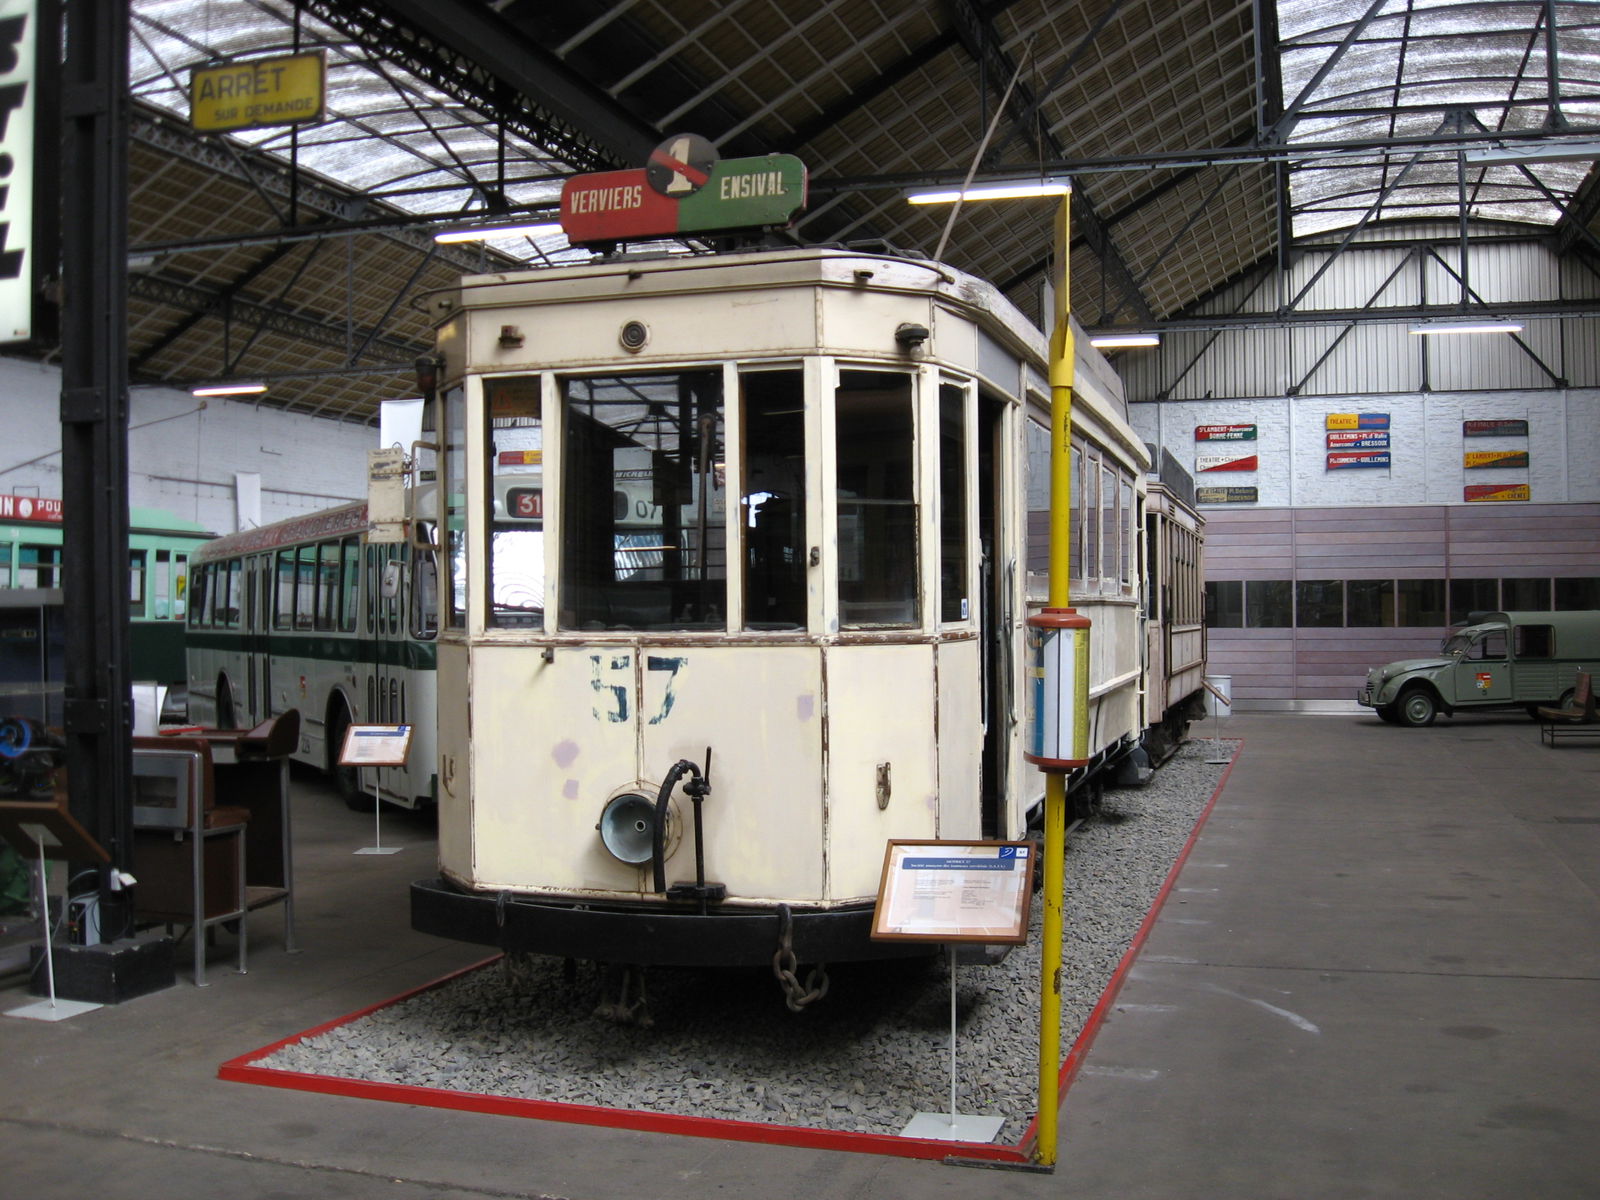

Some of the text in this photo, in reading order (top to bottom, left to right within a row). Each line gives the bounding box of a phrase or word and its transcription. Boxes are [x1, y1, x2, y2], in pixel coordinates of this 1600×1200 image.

[199, 66, 286, 102] ARRET
[214, 97, 314, 120] SUR DEMANDE
[665, 137, 693, 193] 1
[570, 185, 643, 215] VERVIERS
[720, 171, 786, 201] ENSIVAL
